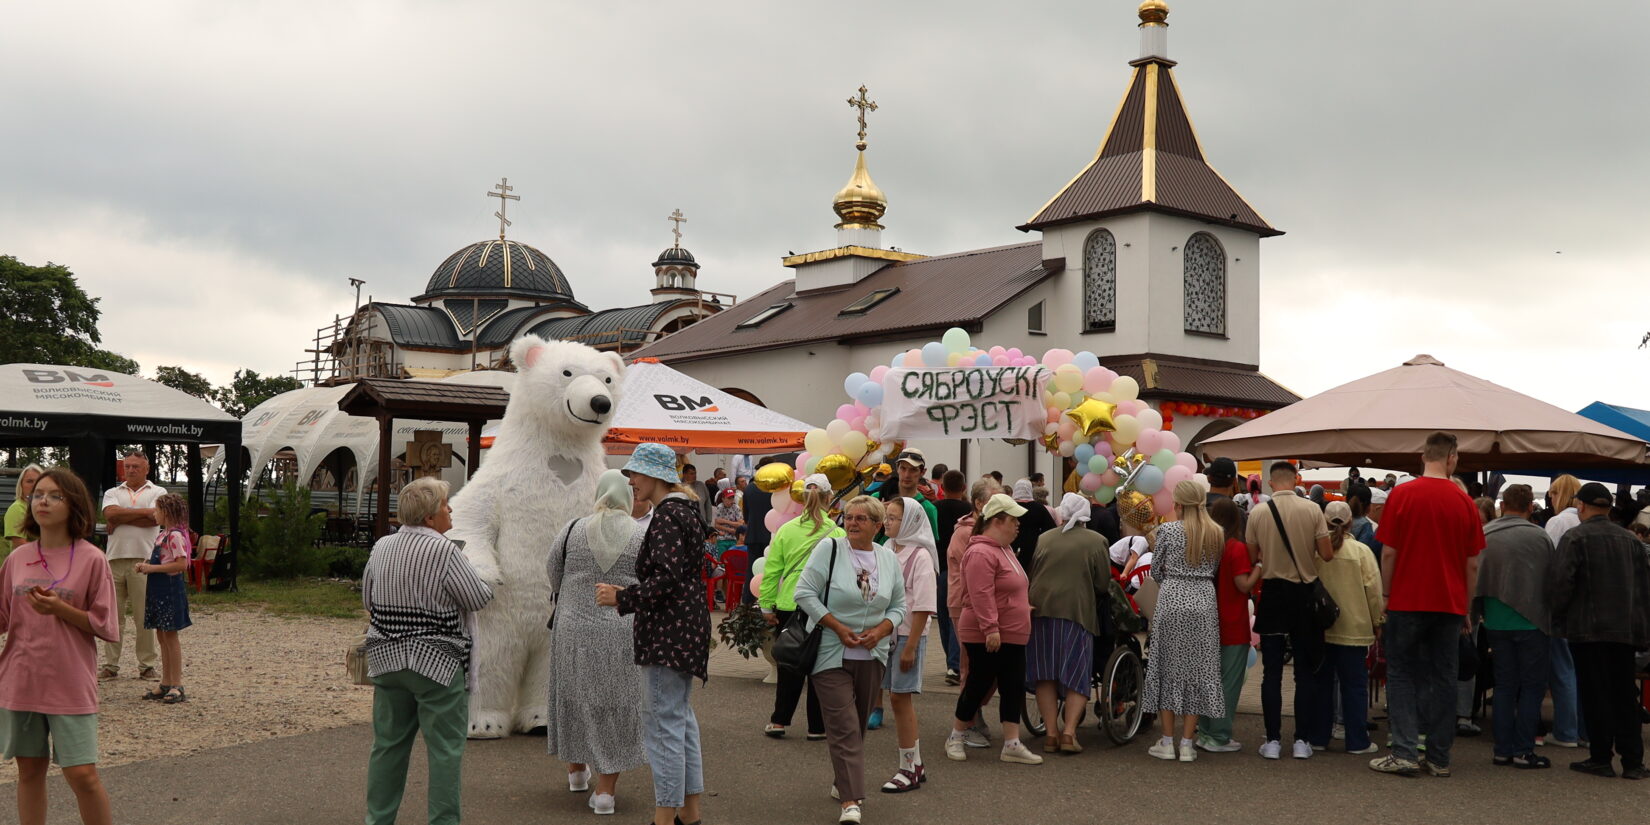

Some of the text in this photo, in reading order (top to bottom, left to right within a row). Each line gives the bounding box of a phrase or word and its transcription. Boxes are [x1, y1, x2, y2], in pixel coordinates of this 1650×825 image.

[33, 387, 122, 398] ВОЛКОВЫССКИЙ
[35, 394, 123, 404] МЯСОКОМБИНАТ
[653, 394, 719, 411] ВМ
[926, 401, 1021, 435] ФЭСТ
[127, 424, 203, 437] www.volmk.by
[639, 434, 689, 444] www.volmk.by
[738, 437, 788, 445] www.volmk.by
